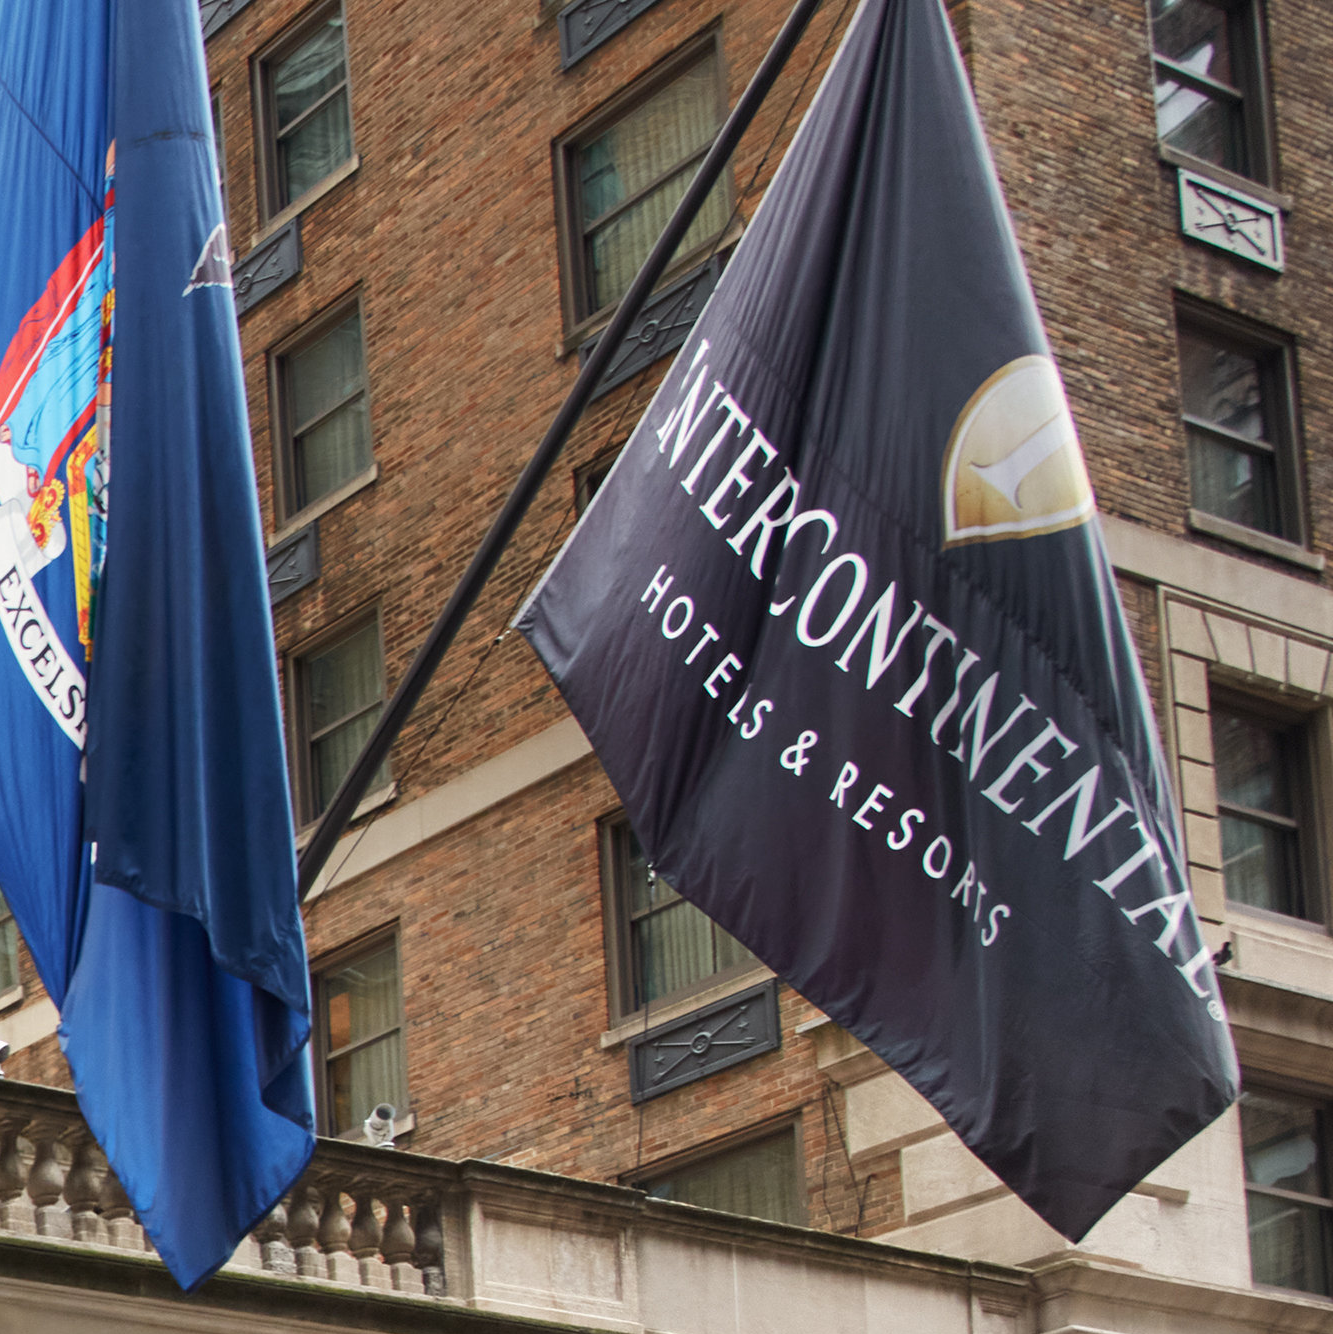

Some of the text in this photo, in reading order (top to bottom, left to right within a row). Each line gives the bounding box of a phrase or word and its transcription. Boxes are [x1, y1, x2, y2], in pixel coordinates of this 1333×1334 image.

[640, 564, 1013, 949] HOTELS & RESORTS
